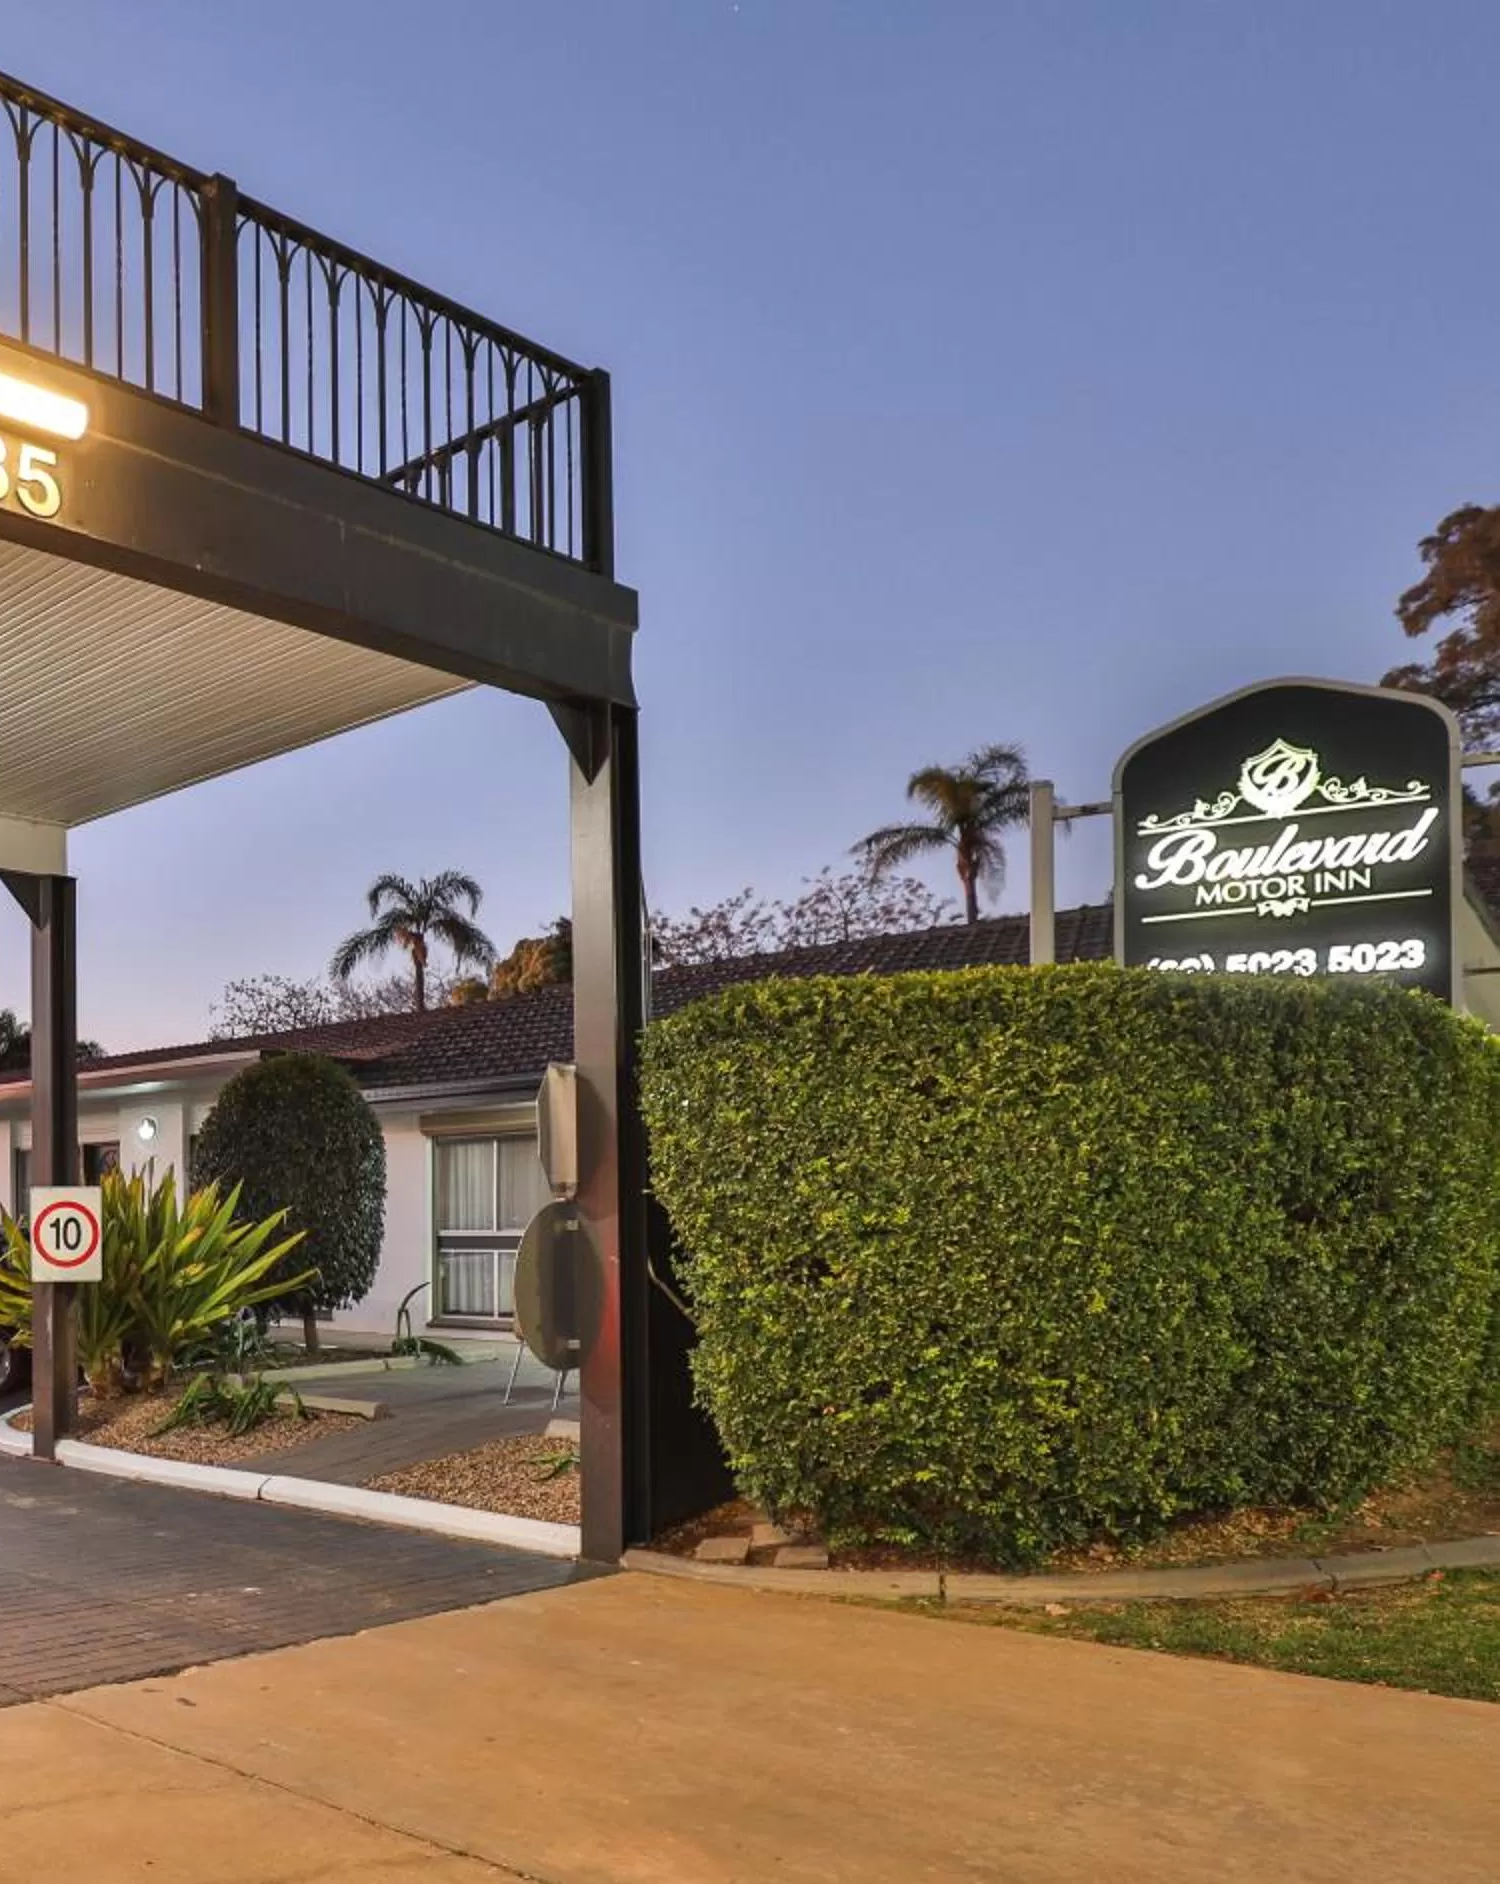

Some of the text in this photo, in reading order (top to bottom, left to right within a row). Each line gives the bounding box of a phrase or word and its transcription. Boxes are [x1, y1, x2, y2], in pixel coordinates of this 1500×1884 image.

[1135, 807, 1439, 890] Boulevard
[1195, 867, 1372, 906] MOTOR INN
[1226, 948, 1318, 977] 5023
[1327, 938, 1426, 973] 5023
[49, 1217, 82, 1251] 10
